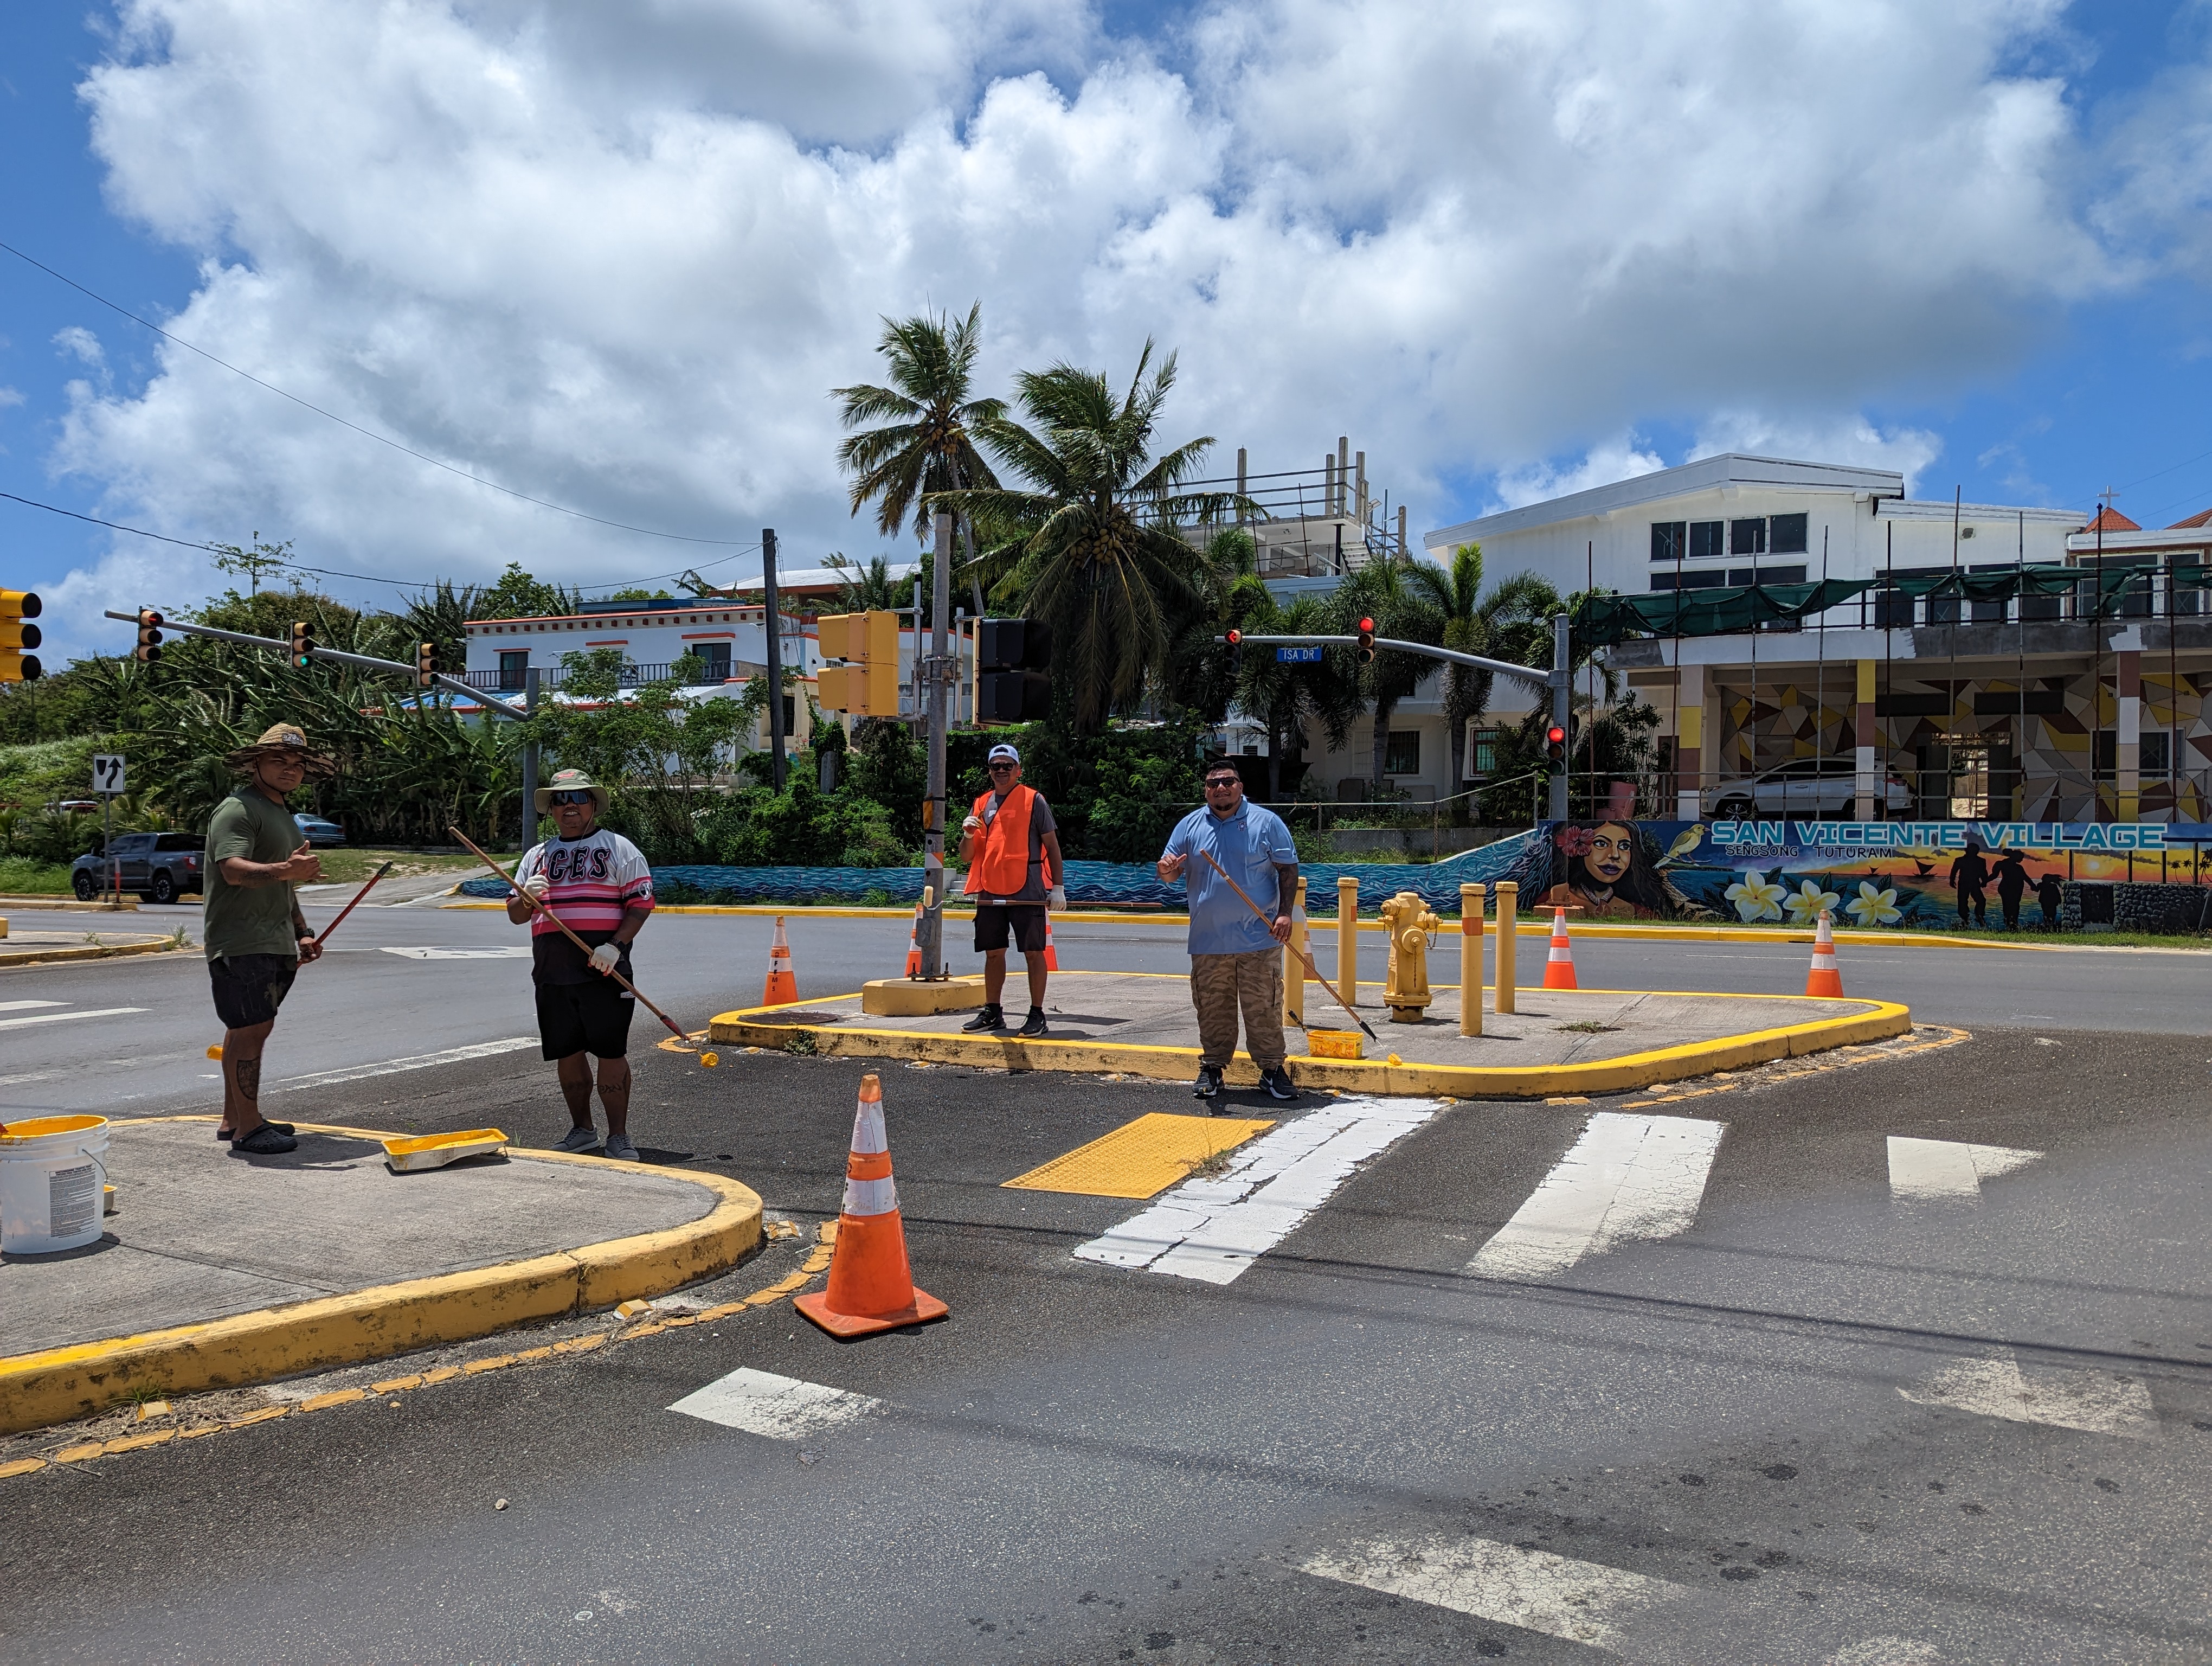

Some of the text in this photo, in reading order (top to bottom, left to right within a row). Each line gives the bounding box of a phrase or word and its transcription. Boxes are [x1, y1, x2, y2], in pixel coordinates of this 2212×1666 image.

[1284, 650, 1314, 660] ISA DR
[1711, 821, 2168, 851] SAN VICENTE VILLAGE
[1725, 844, 1893, 859] SENGSONG TUTURAM
